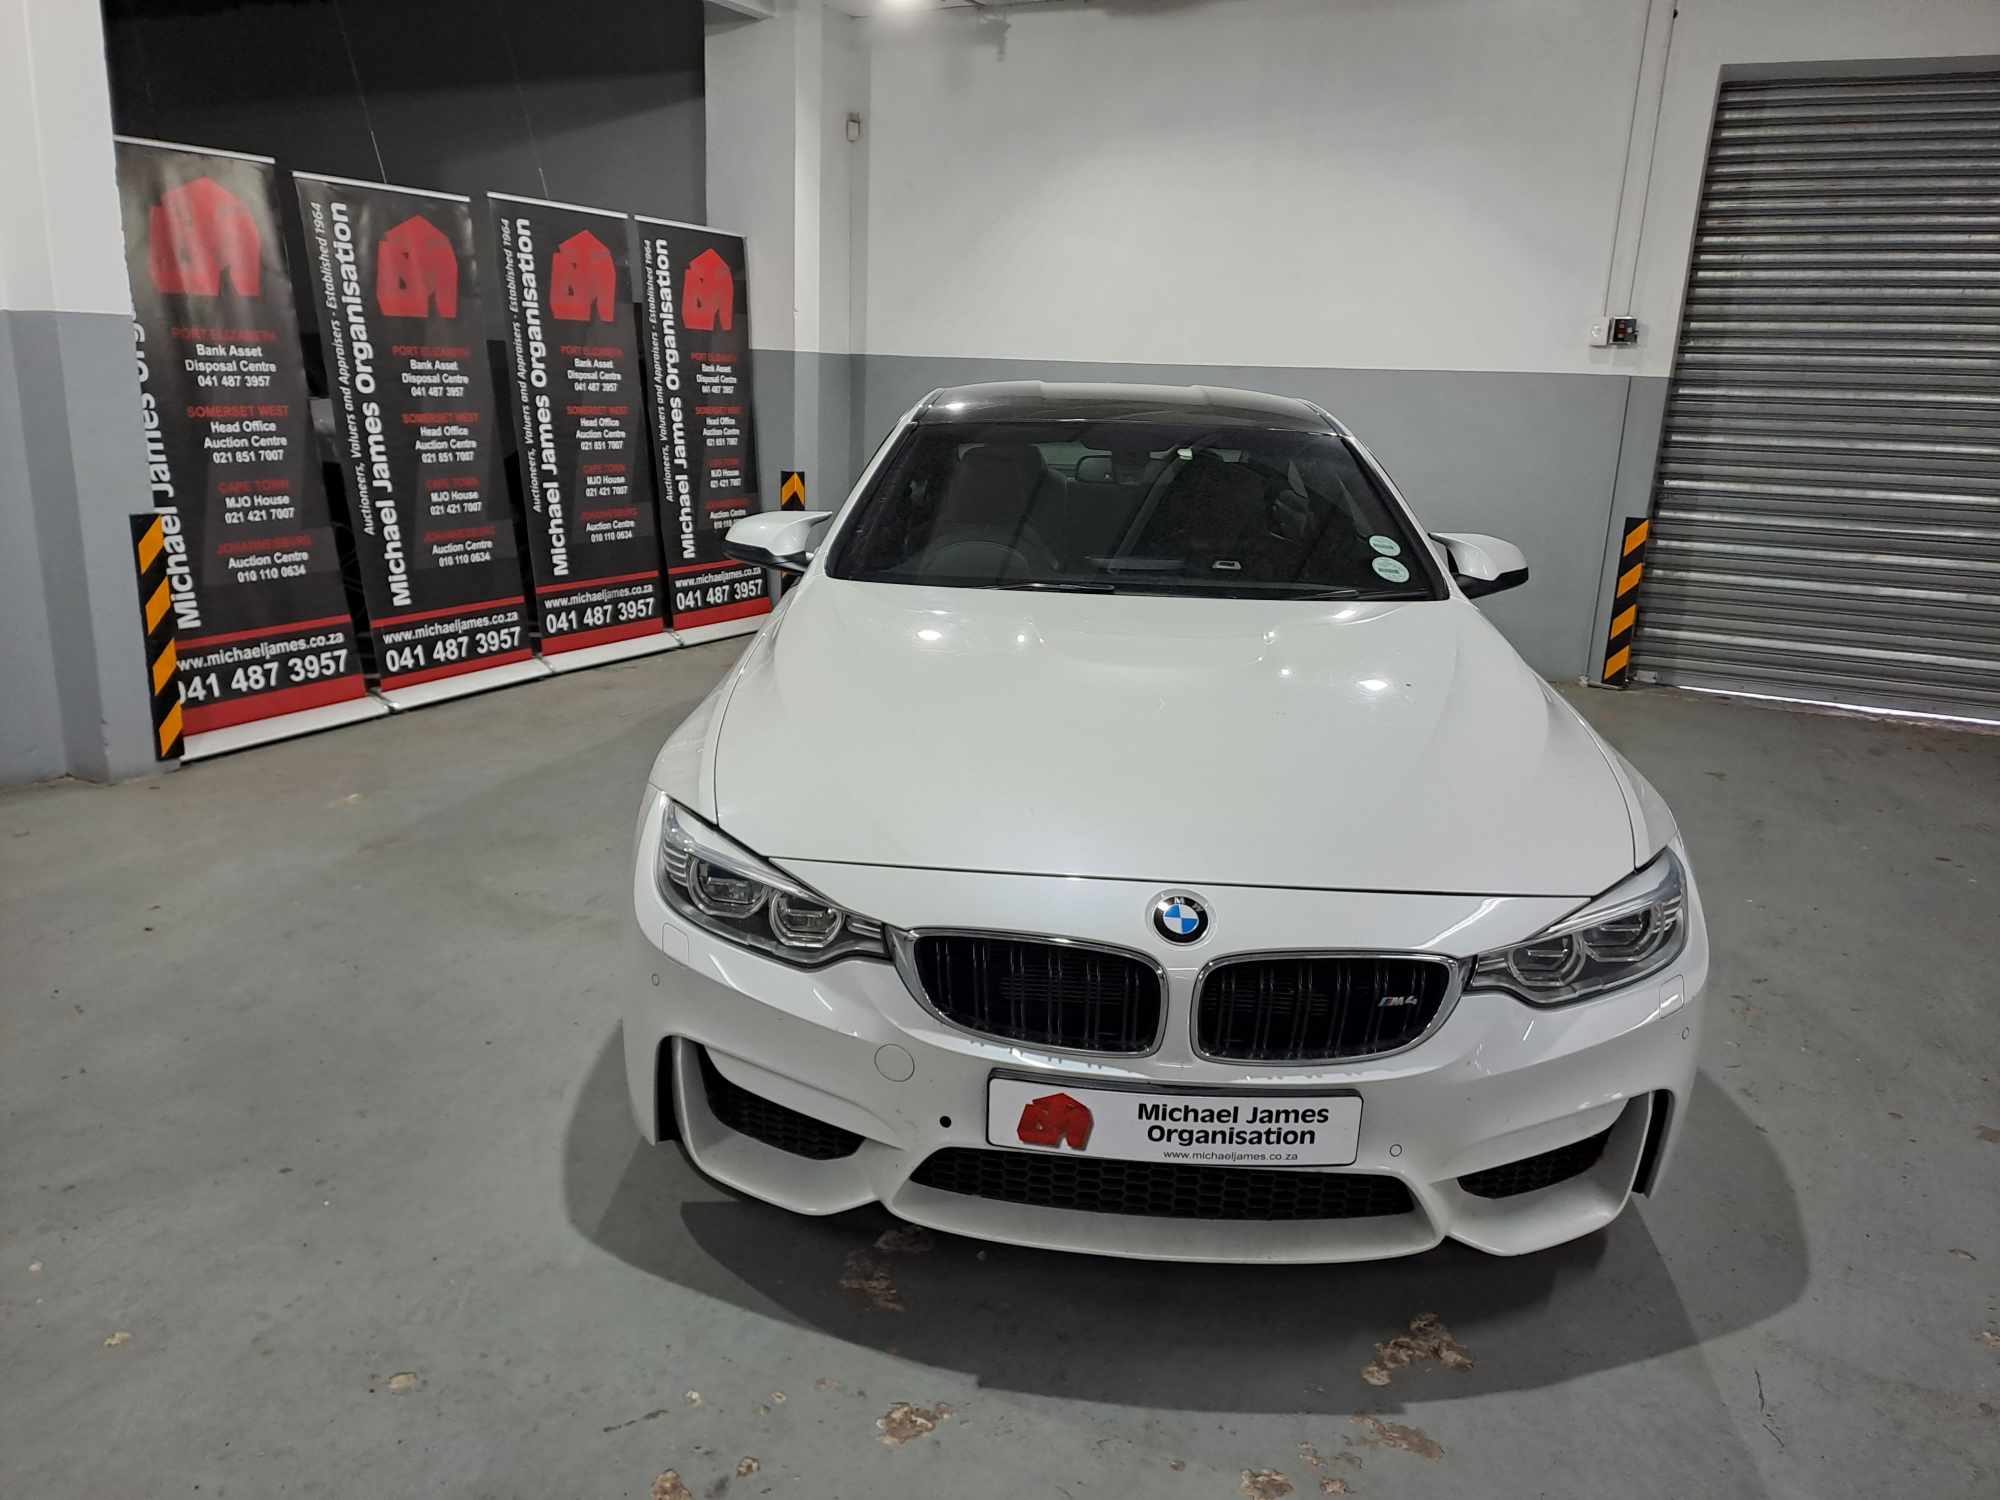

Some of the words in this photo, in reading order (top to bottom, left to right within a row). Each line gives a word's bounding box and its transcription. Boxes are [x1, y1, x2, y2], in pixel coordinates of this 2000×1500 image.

[311, 202, 326, 234] 1964
[316, 236, 339, 310] Established
[503, 249, 518, 313] Established
[331, 202, 376, 394] Organisation
[516, 218, 547, 388] Organisation
[655, 239, 680, 391] Organisation
[185, 359, 237, 373] Disposal
[239, 360, 277, 372] Centre
[196, 344, 226, 356] Bank
[229, 345, 263, 357] Asset
[331, 319, 350, 387] Appraisers
[410, 359, 432, 370] Bank
[434, 360, 458, 370] Asset
[513, 322, 527, 380] Appraisers
[197, 375, 218, 387] 041
[221, 375, 241, 387] 487
[245, 375, 270, 387] 3957
[402, 372, 440, 384] Disposal
[442, 373, 469, 384] Centre
[518, 381, 530, 403] and
[343, 387, 355, 411] and
[210, 421, 240, 433] Head
[242, 420, 277, 432] Office
[348, 412, 362, 459] Valuers
[420, 426, 442, 436] Head
[444, 425, 469, 436] Office
[522, 404, 534, 444] Valuers
[536, 395, 557, 475] James
[669, 396, 688, 469] James
[204, 437, 249, 448] Auction
[251, 435, 288, 447] Centre
[213, 452, 233, 463] 021
[235, 451, 256, 462] 851
[258, 449, 284, 461] 7007
[362, 401, 393, 493] James
[415, 440, 448, 450] Auction
[450, 439, 477, 449] Centre
[224, 511, 244, 524] 021
[247, 509, 267, 521] 421
[270, 507, 295, 519] 7007
[225, 496, 251, 508] MJO
[253, 494, 290, 506] House
[675, 474, 696, 559] Michael
[542, 481, 569, 576] Michael
[228, 556, 272, 569] Auction
[273, 552, 309, 563] Centre
[375, 500, 412, 607] Michael
[432, 543, 464, 555] Auction
[465, 541, 493, 551] Centre
[154, 506, 202, 630] Michael
[544, 584, 653, 609] www.michaeljames.co.za
[676, 589, 701, 610] 041
[706, 585, 729, 604] 487
[733, 579, 762, 600] 3957
[383, 611, 519, 645] www.michaeljames.co.za
[545, 610, 577, 634] 041
[583, 604, 612, 626] 487
[617, 597, 655, 621] 3957
[176, 632, 345, 672] ww.michaeljames.co.za
[386, 644, 425, 672] 041
[432, 635, 469, 662] 487
[475, 626, 521, 654] 3957
[231, 662, 279, 692] 487
[287, 649, 348, 682] 3957
[1137, 1103, 1239, 1124] Michael
[1246, 1106, 1330, 1124] James
[1147, 1125, 1316, 1146] Organisation
[1163, 1151, 1299, 1162] www.michaeljames.co.za
